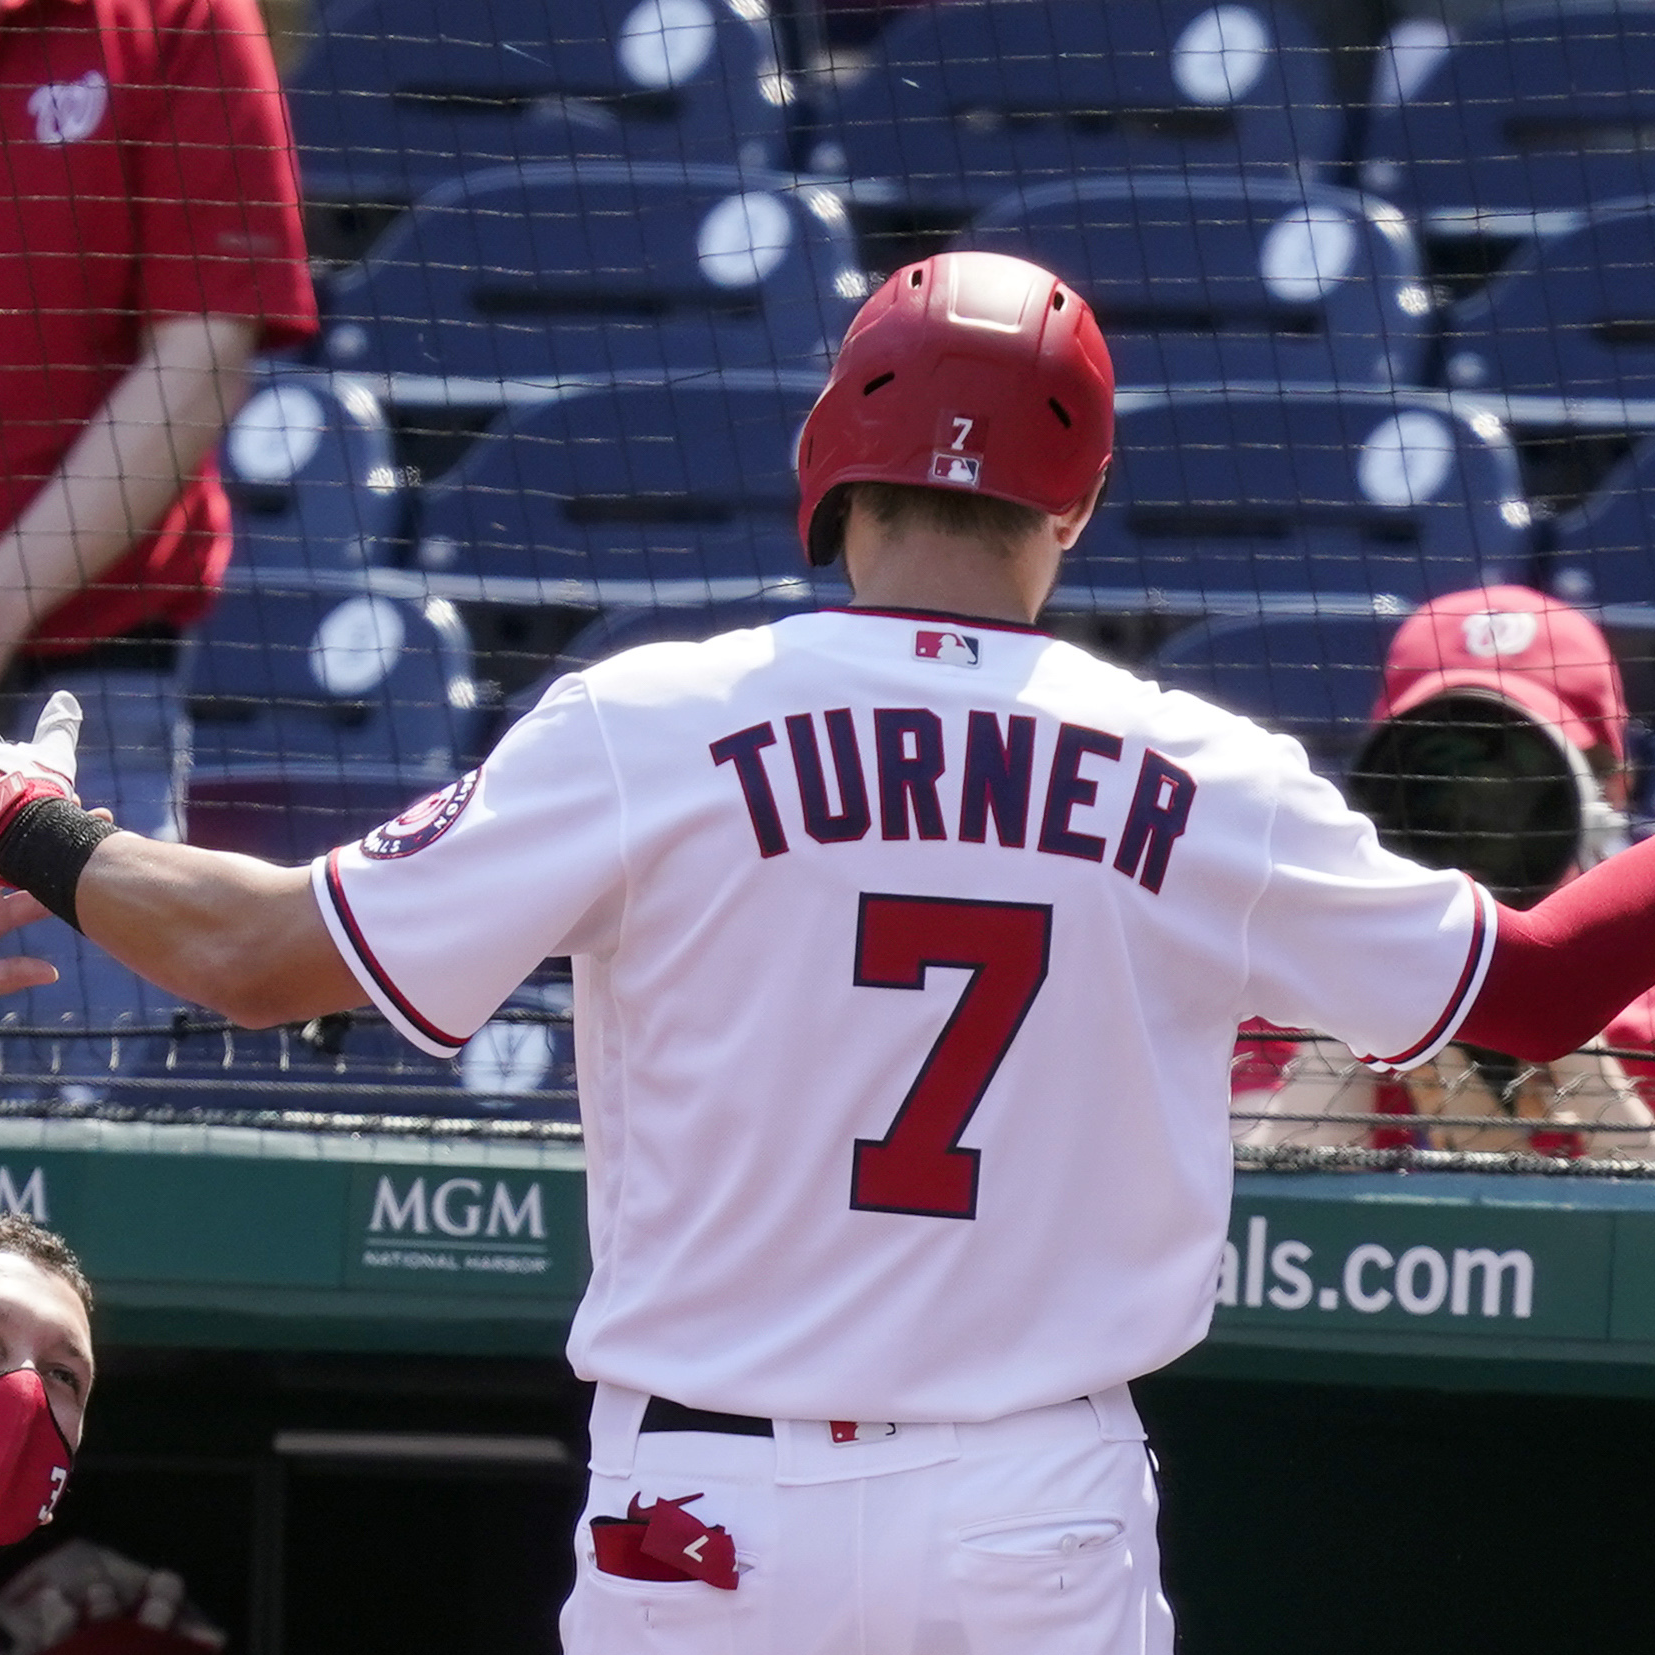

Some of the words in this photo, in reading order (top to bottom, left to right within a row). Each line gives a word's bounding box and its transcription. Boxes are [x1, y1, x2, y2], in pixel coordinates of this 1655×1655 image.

[951, 417, 973, 450] 7
[709, 707, 1198, 896] TURNER
[849, 891, 1054, 1221] 7
[367, 1174, 548, 1239] MGM
